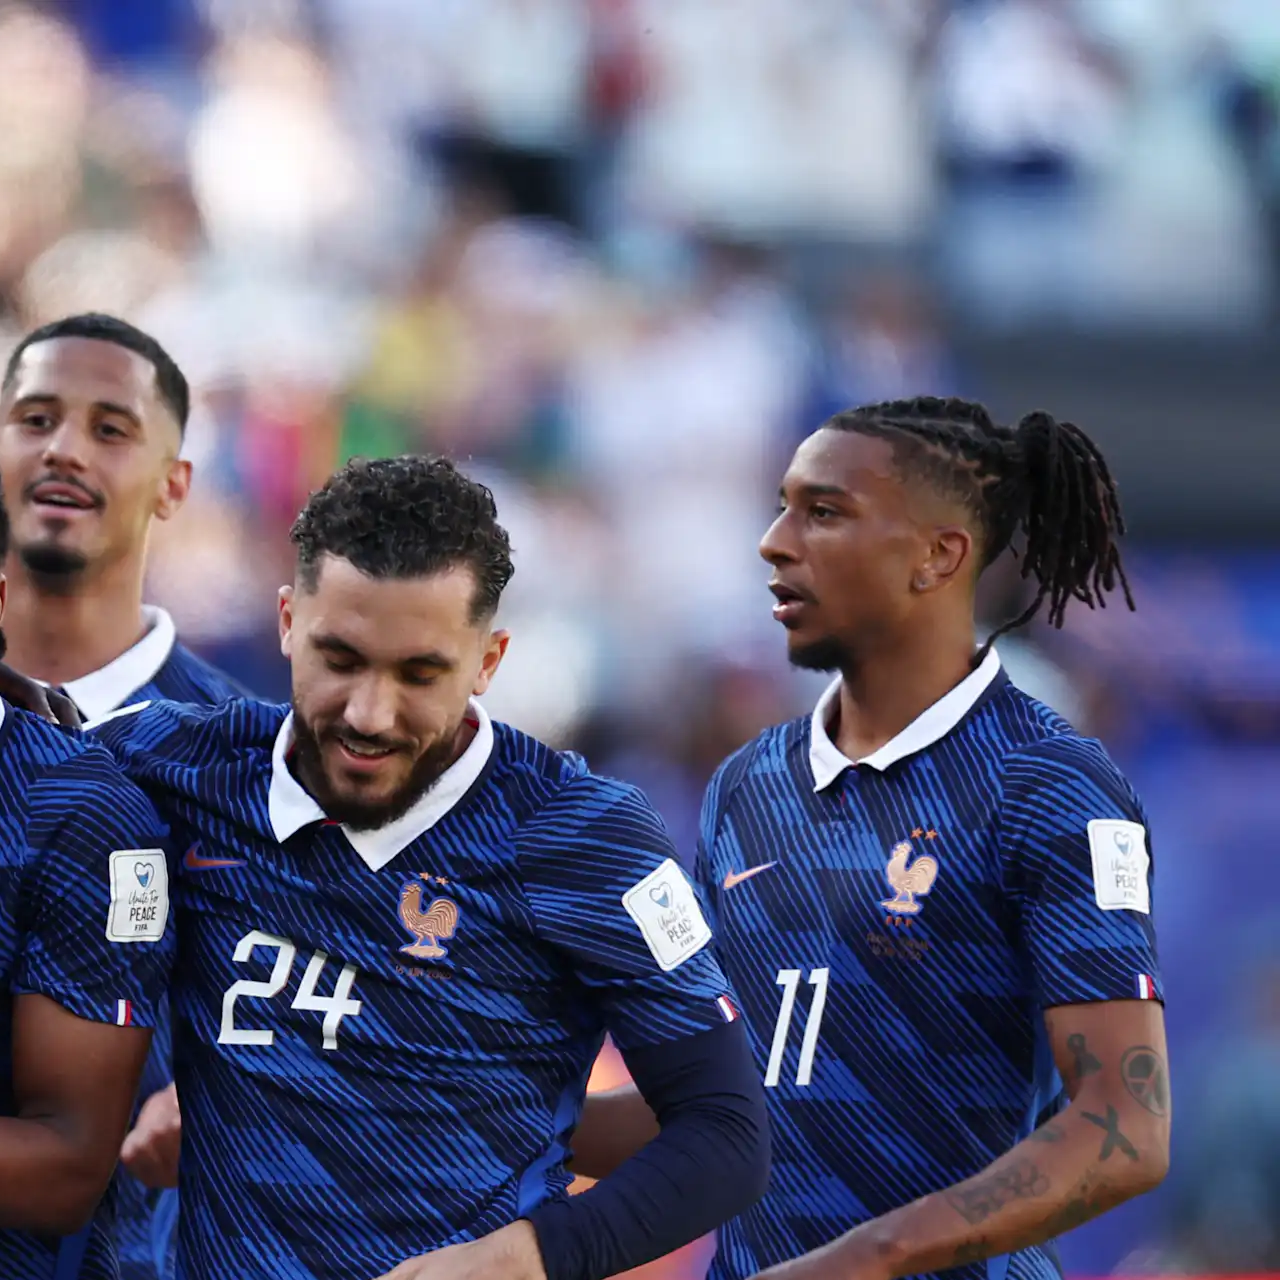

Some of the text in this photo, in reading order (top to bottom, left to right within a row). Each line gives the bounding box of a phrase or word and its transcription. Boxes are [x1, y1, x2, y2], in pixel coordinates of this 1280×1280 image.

[129, 906, 157, 922] PEACE
[216, 929, 363, 1051] 24
[763, 966, 830, 1088] 11
